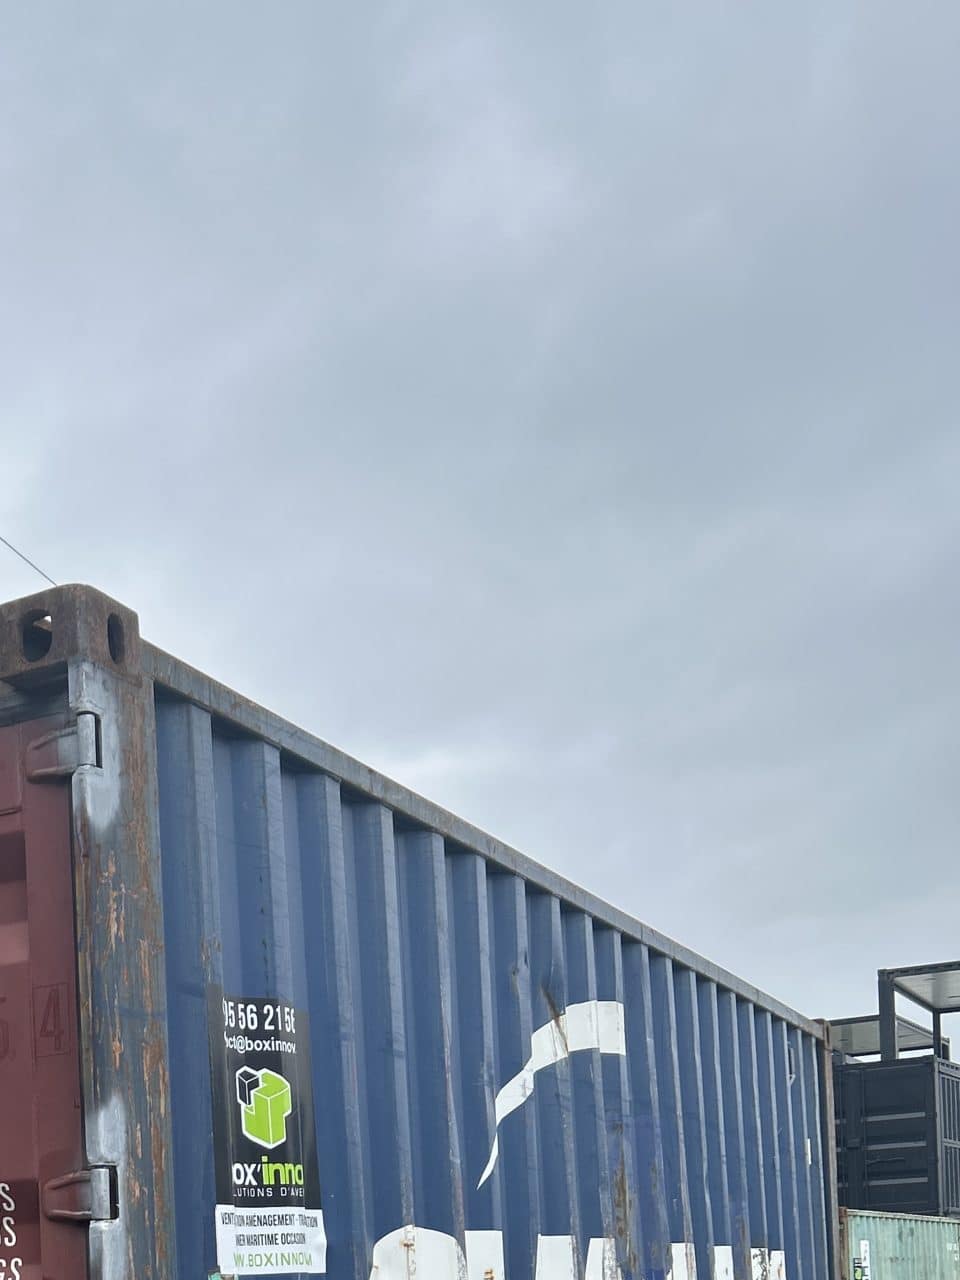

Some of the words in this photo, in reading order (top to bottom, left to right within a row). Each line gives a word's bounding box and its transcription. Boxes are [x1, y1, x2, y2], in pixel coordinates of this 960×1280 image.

[40, 988, 65, 1052] 4
[238, 1003, 258, 1030] 56
[263, 1004, 282, 1031] 21
[246, 1233, 278, 1246] MARITIME
[281, 1232, 306, 1245] OCCASION
